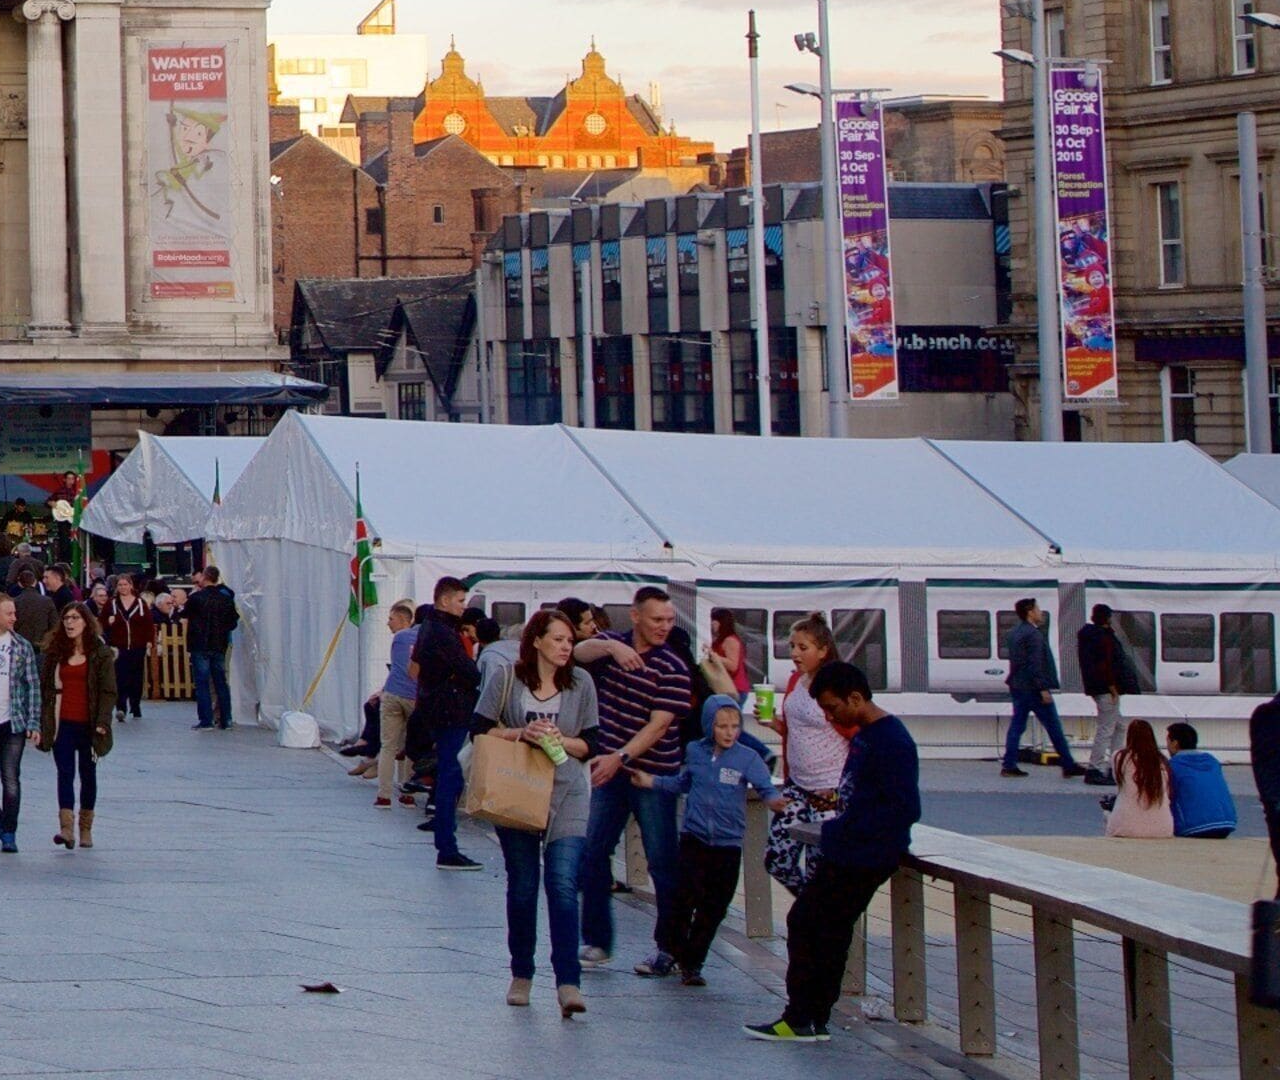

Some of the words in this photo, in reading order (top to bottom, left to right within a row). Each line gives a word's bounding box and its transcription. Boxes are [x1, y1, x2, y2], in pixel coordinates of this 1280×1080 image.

[151, 55, 224, 70] WANTED
[152, 73, 177, 82] LOW
[181, 71, 224, 82] ENERGY
[174, 81, 204, 91] BILLS
[1054, 89, 1099, 102] Goose
[1055, 102, 1080, 115] Fair
[838, 120, 880, 130] Goose
[1055, 125, 1069, 135] 30
[1070, 124, 1093, 136] Sep
[840, 130, 864, 142] Fair
[1056, 139, 1064, 148] 4
[1065, 138, 1086, 149] Oct
[840, 151, 853, 160] 30
[854, 150, 875, 162] Sep
[1056, 151, 1084, 162] 2015
[840, 163, 849, 172] 4
[849, 163, 868, 173] Oct
[841, 175, 866, 185] 2015
[1058, 172, 1086, 180] Forest
[1058, 181, 1104, 189] Recreation
[1058, 189, 1090, 198] Ground
